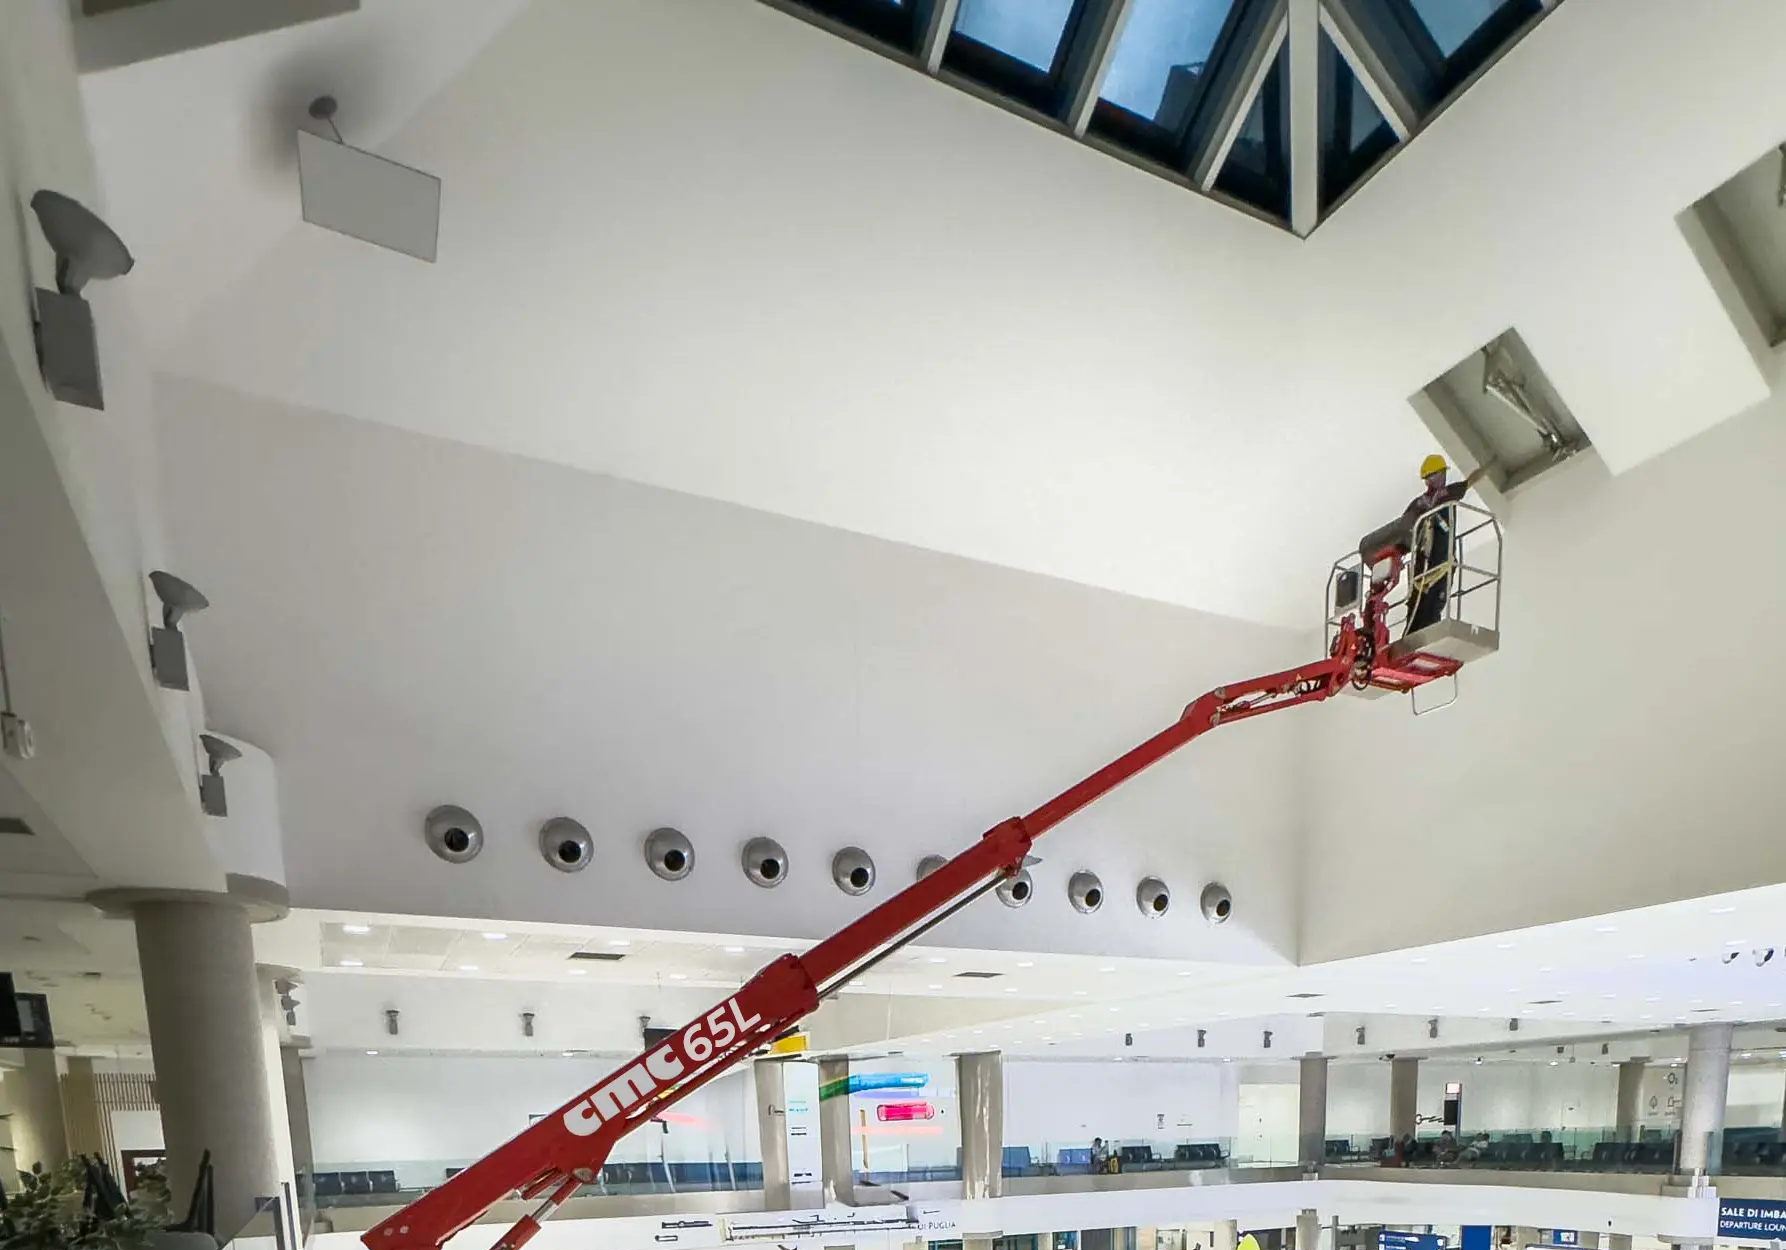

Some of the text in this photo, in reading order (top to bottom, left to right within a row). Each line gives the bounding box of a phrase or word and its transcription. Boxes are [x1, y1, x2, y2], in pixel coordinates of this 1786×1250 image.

[563, 998, 761, 1136] cmc 65L
[1721, 1207, 1786, 1219] SALE DI IMBA
[928, 1221, 956, 1230] PUGLIA
[1720, 1220, 1762, 1231] DEPARTURE
